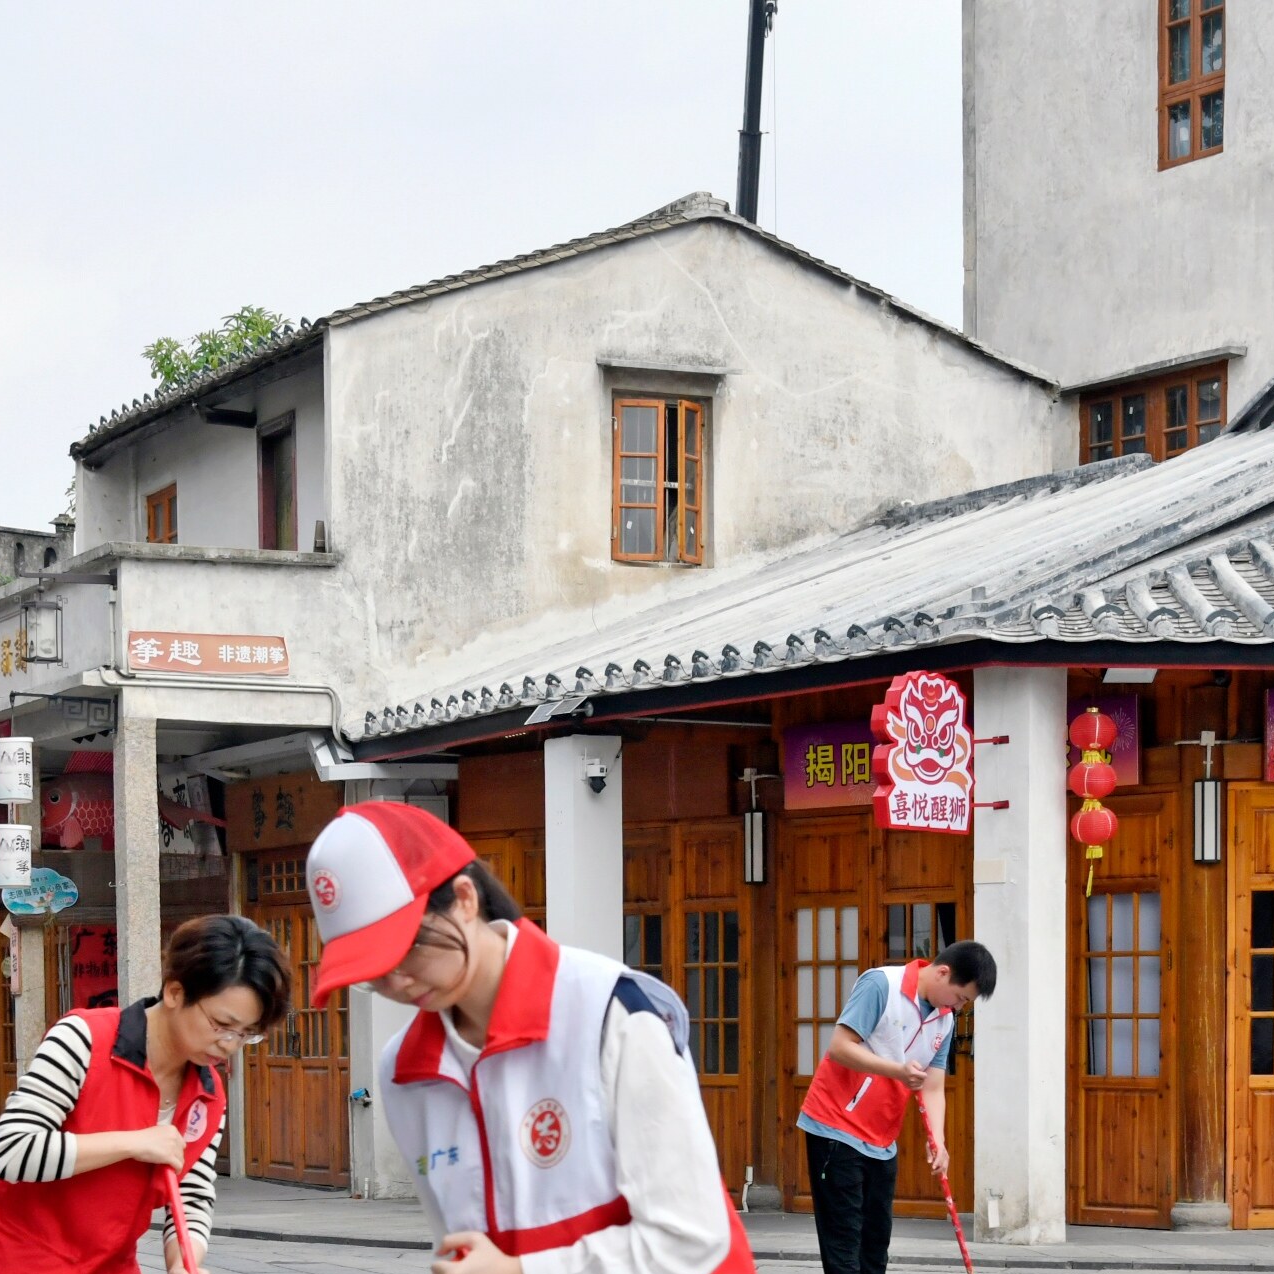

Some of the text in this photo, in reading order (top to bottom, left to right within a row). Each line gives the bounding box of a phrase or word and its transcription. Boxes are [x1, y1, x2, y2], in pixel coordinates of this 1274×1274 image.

[130, 637, 285, 666] 筝趣 非遗潮筝
[17, 748, 31, 788] 非遗
[805, 743, 870, 788] 揭阳
[891, 790, 966, 826] 喜悦醒狮
[7, 880, 72, 900] 志愿服务爱心商家
